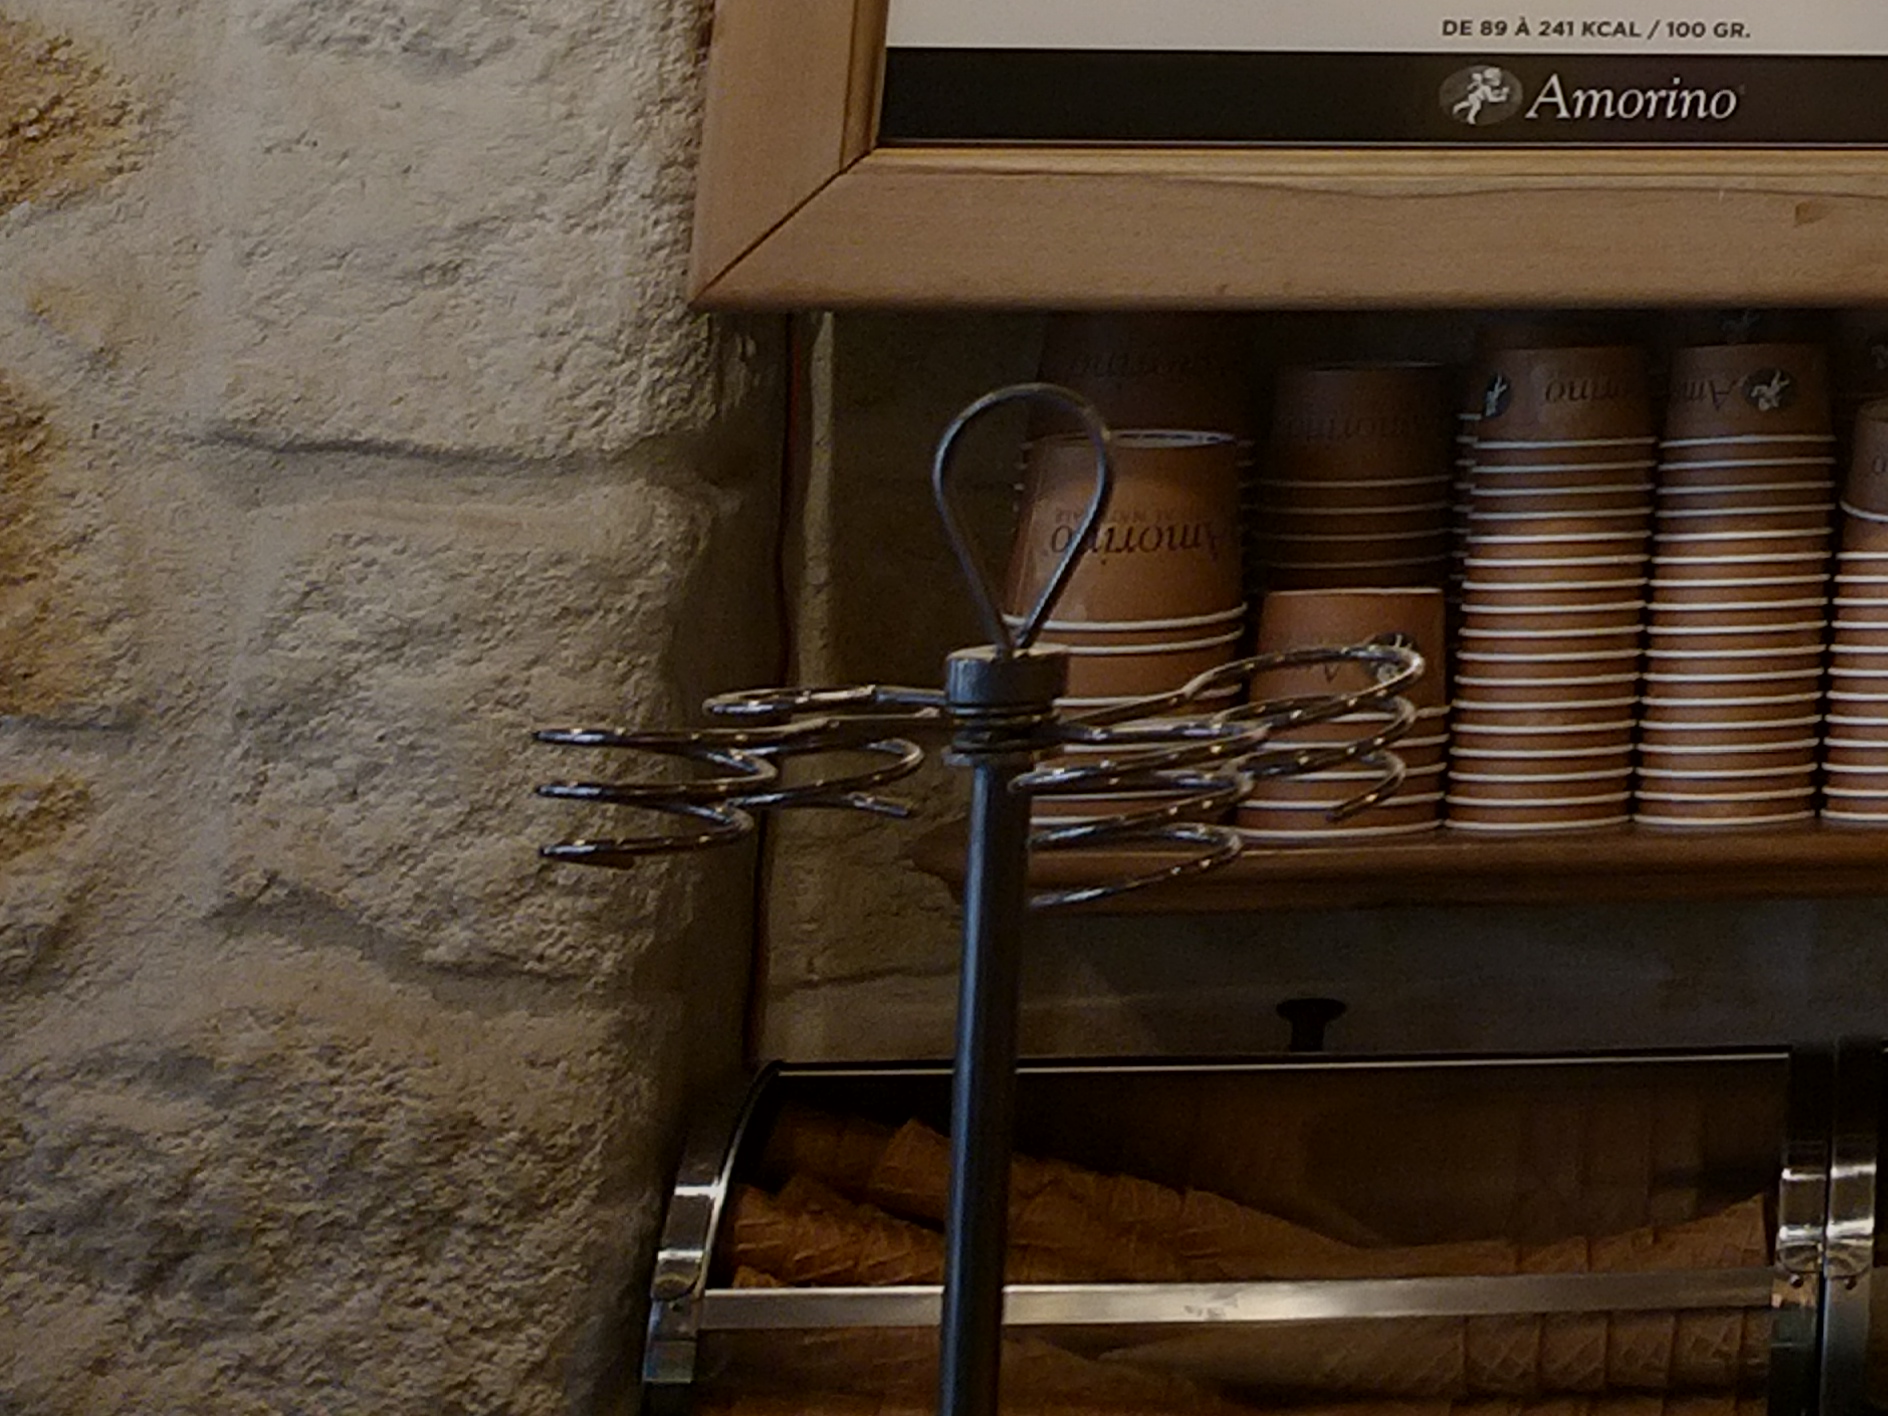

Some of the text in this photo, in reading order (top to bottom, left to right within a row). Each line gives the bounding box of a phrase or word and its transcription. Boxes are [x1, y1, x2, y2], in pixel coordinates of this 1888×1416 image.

[1442, 15, 1751, 40] DE 89 À 241 KCAL / 100 GR.
[1524, 72, 1737, 120] Amorino
